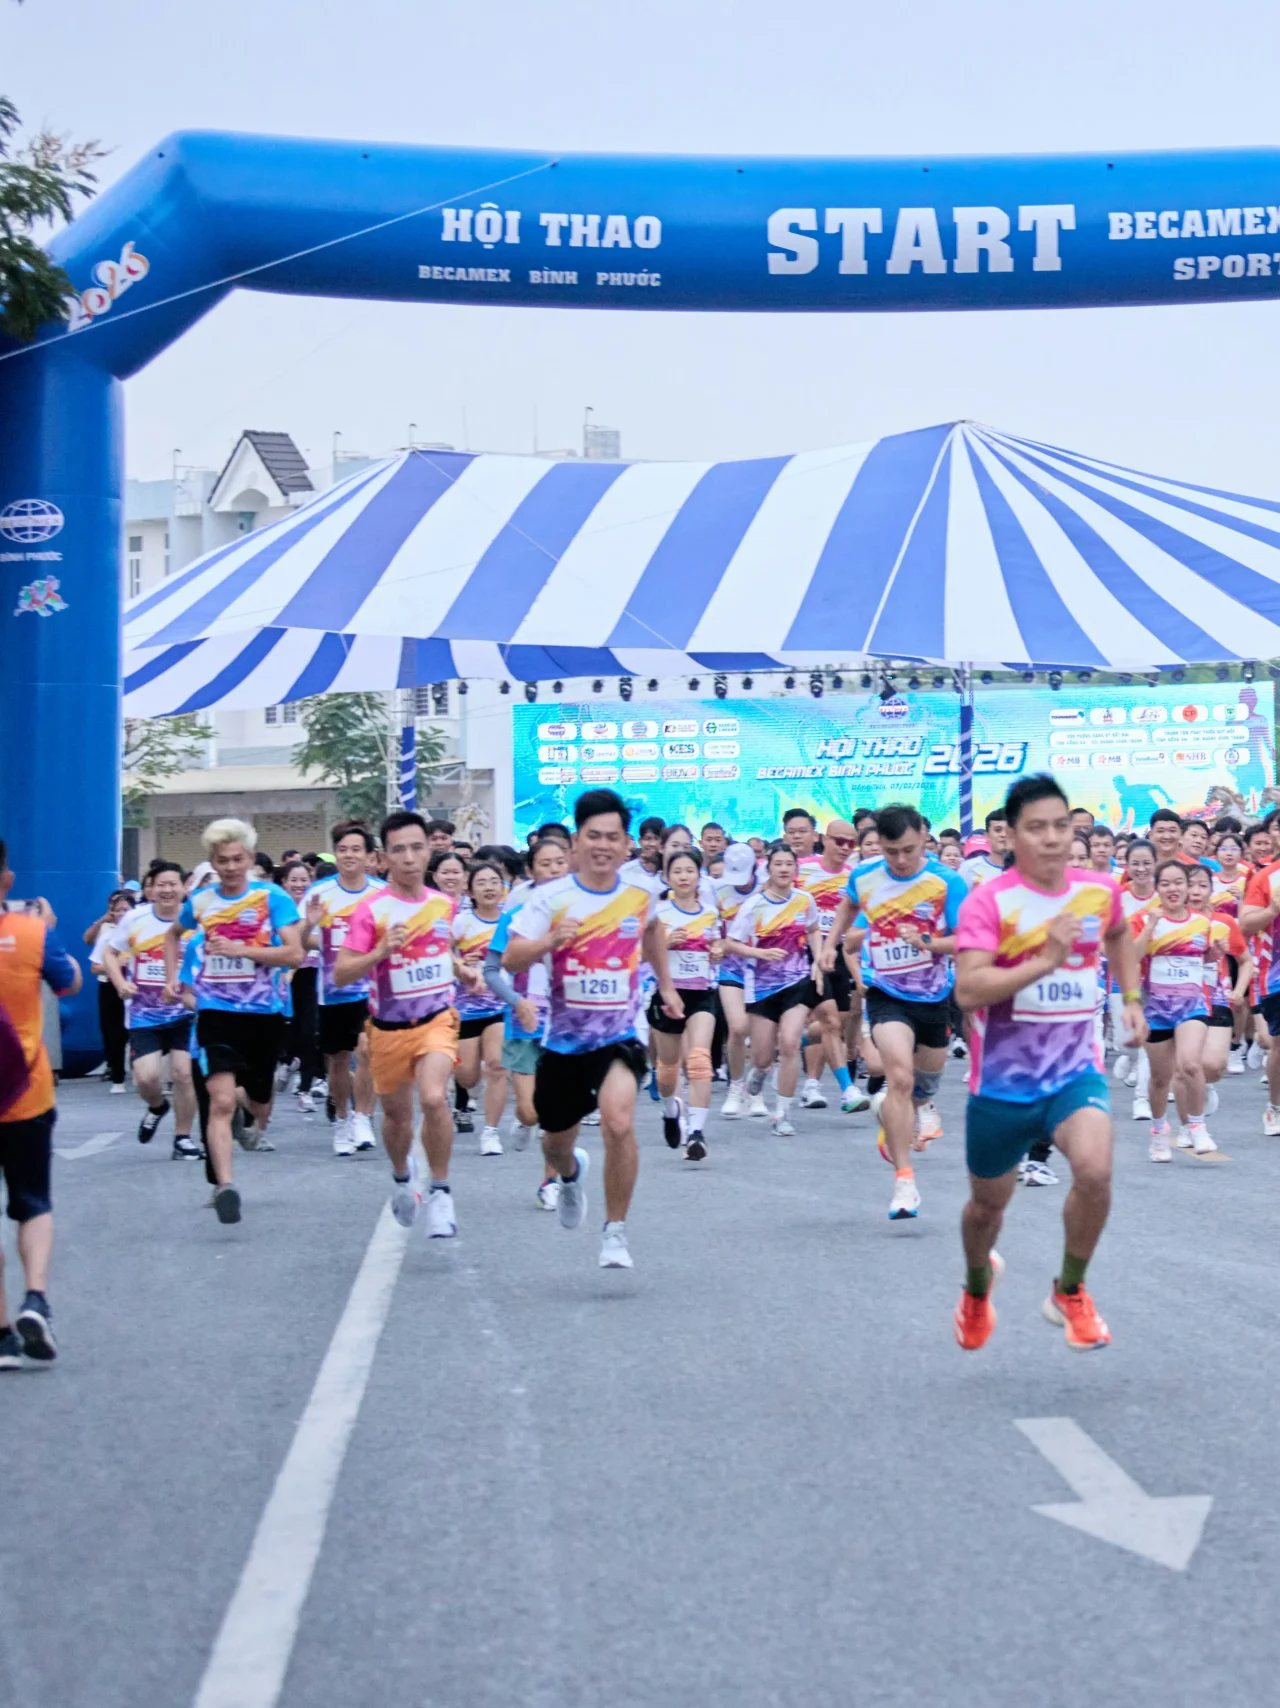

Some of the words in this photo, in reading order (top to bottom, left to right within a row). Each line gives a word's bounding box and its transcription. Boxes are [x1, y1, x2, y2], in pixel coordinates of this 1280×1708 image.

[441, 202, 522, 249] HỘI
[539, 211, 662, 249] THAO
[766, 203, 1077, 275] START
[418, 264, 511, 282] BECAMEX
[862, 736, 924, 758] THAO
[756, 765, 827, 779] BECAMEX
[885, 945, 920, 962] 1079
[406, 964, 443, 984] 1087
[579, 979, 618, 995] 1261
[1036, 981, 1083, 1002] 1094
